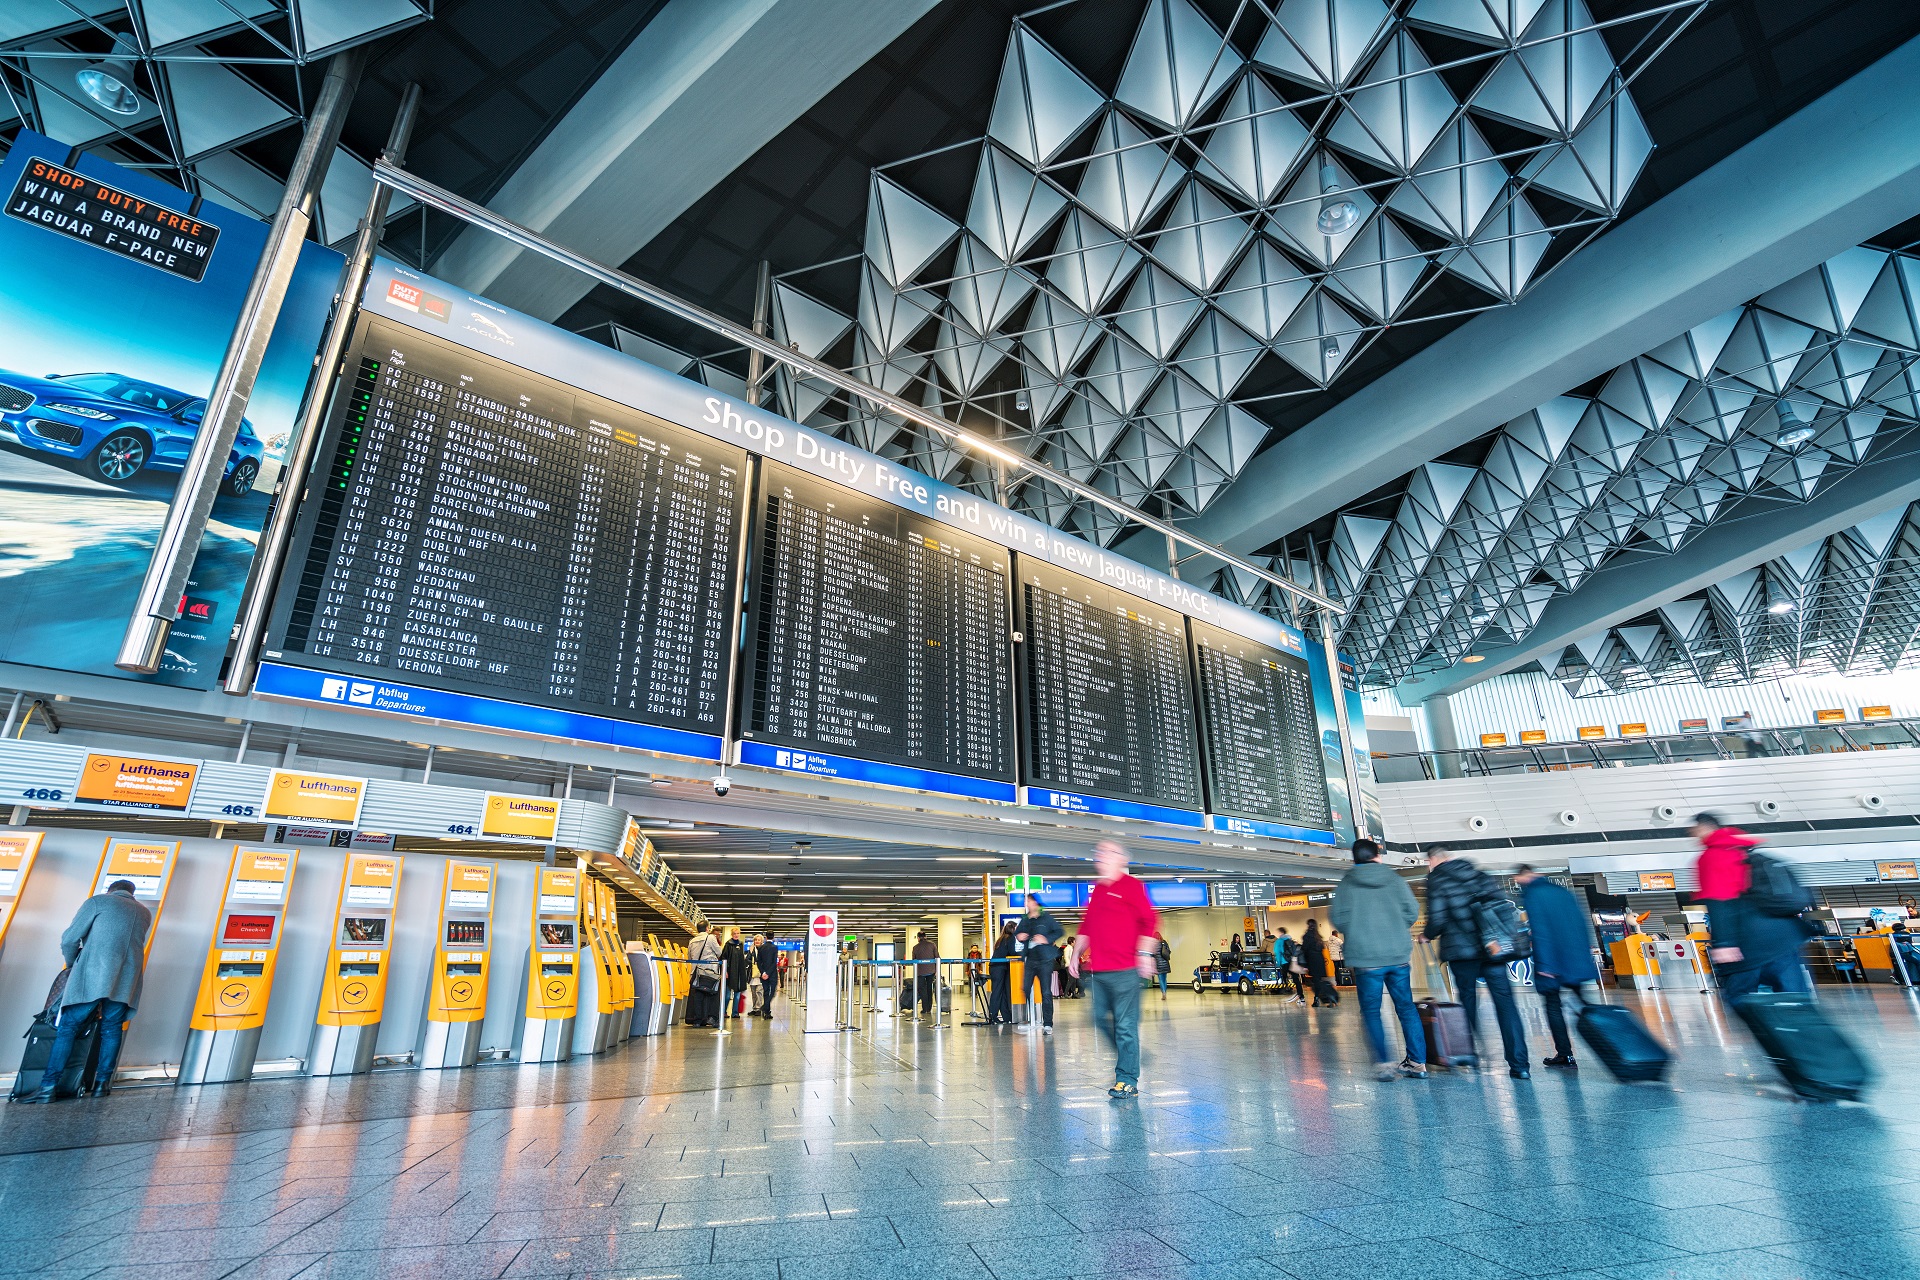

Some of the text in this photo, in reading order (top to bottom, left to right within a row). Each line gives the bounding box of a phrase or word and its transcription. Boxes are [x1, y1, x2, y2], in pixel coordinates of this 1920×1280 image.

[33, 163, 202, 236] SHOP DUTY FREE
[23, 180, 208, 258] WIN A BRAND NEW
[13, 200, 177, 267] JAGUAR F-PACE
[392, 290, 417, 304] FREE
[394, 283, 419, 297] DUTY
[461, 325, 515, 347] JAGUAR
[389, 355, 405, 366] Flight
[390, 349, 404, 359] Flug
[414, 387, 556, 440] 1592 ISTANBUL-ATATURK
[423, 379, 580, 438] 334 ISTANBUL-SABIHA GOK.
[413, 420, 538, 466] 274 MAILAND-LINATE
[416, 410, 528, 452] 190 BERLIN-TEGEL
[401, 439, 470, 466] 1240 WIEN
[410, 430, 498, 464] 464 ASHGABAT
[406, 451, 527, 494] 138 ROM-FIUMICINO
[400, 473, 536, 519] 914 LONDON-HEATHROW
[402, 462, 550, 512] 804 STOCKHOLM-ARLANDA
[390, 482, 495, 518] 1132 BARCELONA
[394, 495, 458, 519] 068 DOHA
[703, 397, 1210, 616] Shop Duty Free and win a new Jaguar F-PACE
[380, 516, 488, 550] 3620 KOELN HBF
[392, 506, 536, 551] 126 AMMAN-QUEEN ALIA
[376, 539, 448, 564] 1222 GENF
[385, 529, 466, 556] 980 DUBLIN
[373, 551, 475, 582] 1350 WARSCHAU
[378, 565, 458, 591] 168 JEDDAH
[374, 576, 484, 608] 956 BIRMINGHAM
[361, 600, 459, 628] 1196 ZUERICH
[364, 587, 542, 632] 1040 PARIS CH. DE GAULLE
[191, 633, 207, 641] with:
[362, 626, 475, 655] 946 MANCHESTER
[365, 613, 478, 644] 811 CASABLANCA
[351, 637, 508, 674] 3518 DUESSELDORF HBF
[356, 652, 442, 674] 264 VERONA
[375, 698, 426, 713] Departures
[378, 686, 409, 701] Abflug
[120, 763, 190, 779] Lufthansa
[807, 755, 827, 766] Abflug
[807, 764, 838, 775] Departures
[115, 781, 175, 793] lufthansa.com
[117, 774, 183, 787] Online Check-in
[300, 779, 357, 794] Lufthansa
[23, 788, 63, 801] 466
[120, 801, 153, 809] ALLIANCE
[509, 801, 555, 813] Lufthansa
[222, 805, 254, 817] 465
[448, 824, 473, 834] 464
[130, 847, 166, 855] Lufthansa
[1046, 885, 1052, 893] C
[1280, 900, 1304, 908] Lufthansa
